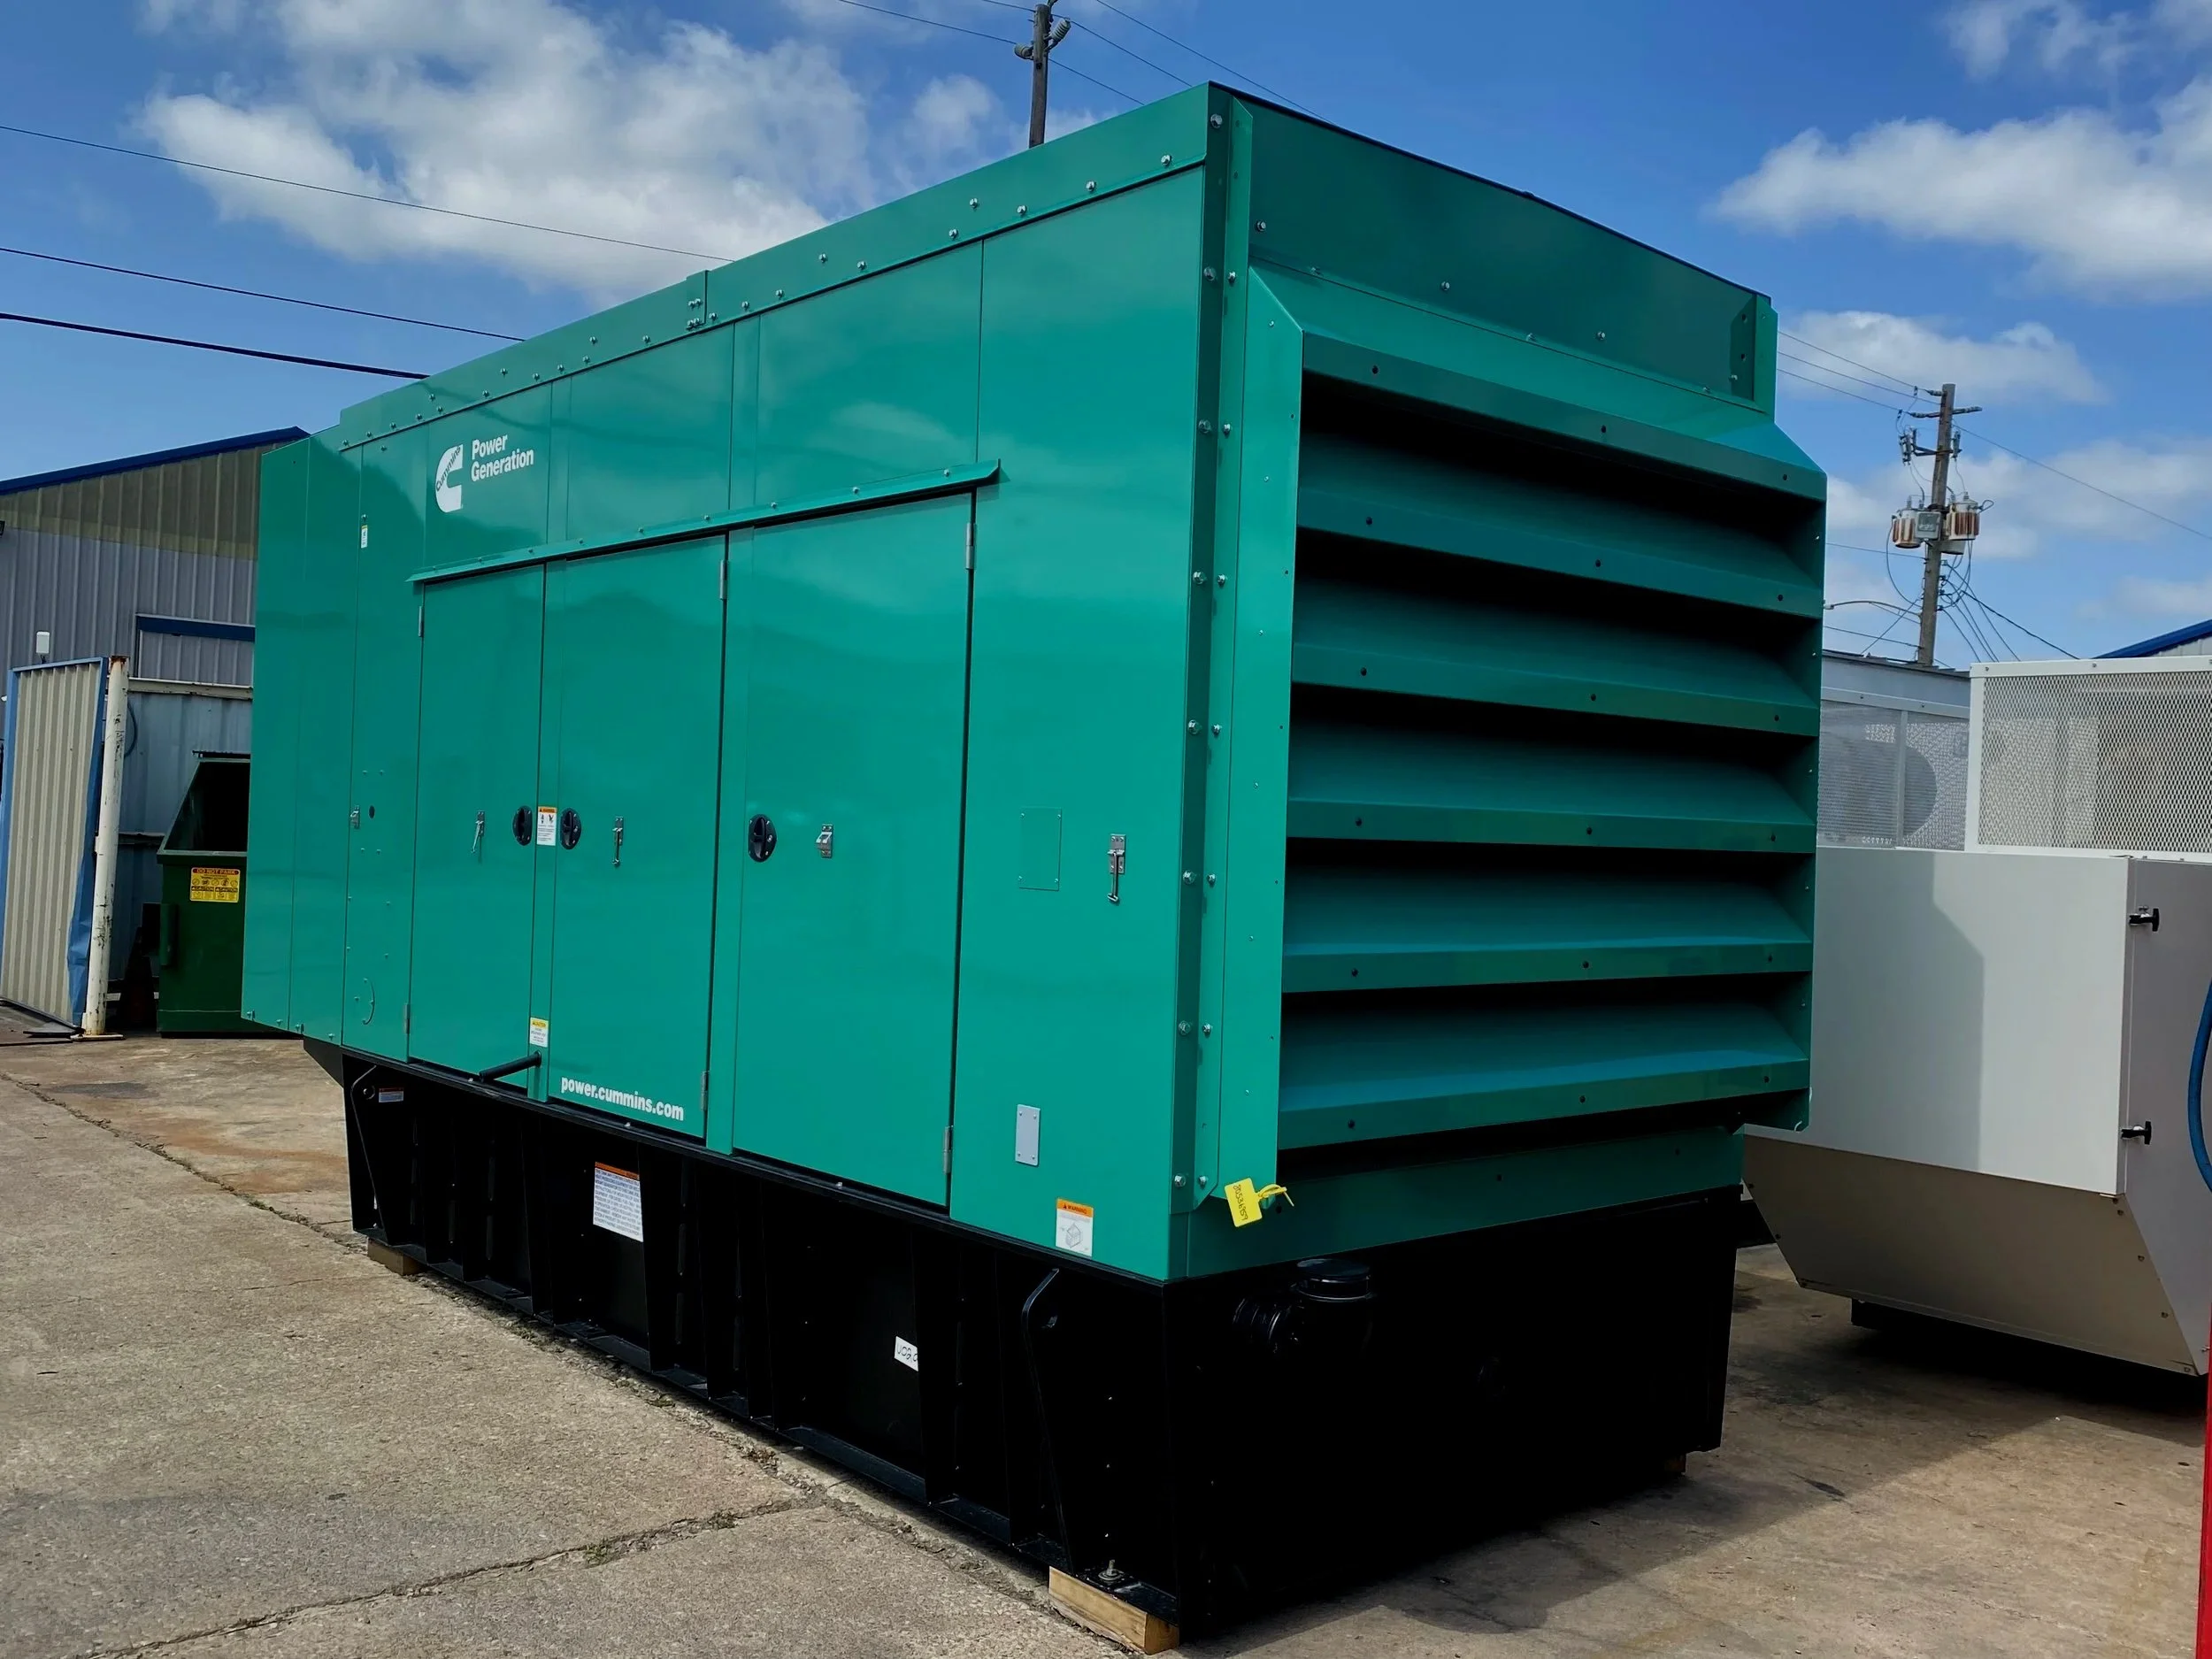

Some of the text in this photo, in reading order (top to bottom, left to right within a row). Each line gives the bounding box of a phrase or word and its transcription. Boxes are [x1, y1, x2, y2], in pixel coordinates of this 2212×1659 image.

[471, 449, 534, 482] Generation
[472, 434, 508, 460] Power
[435, 445, 461, 492] Cummins
[561, 1076, 684, 1122] power.cummins.com
